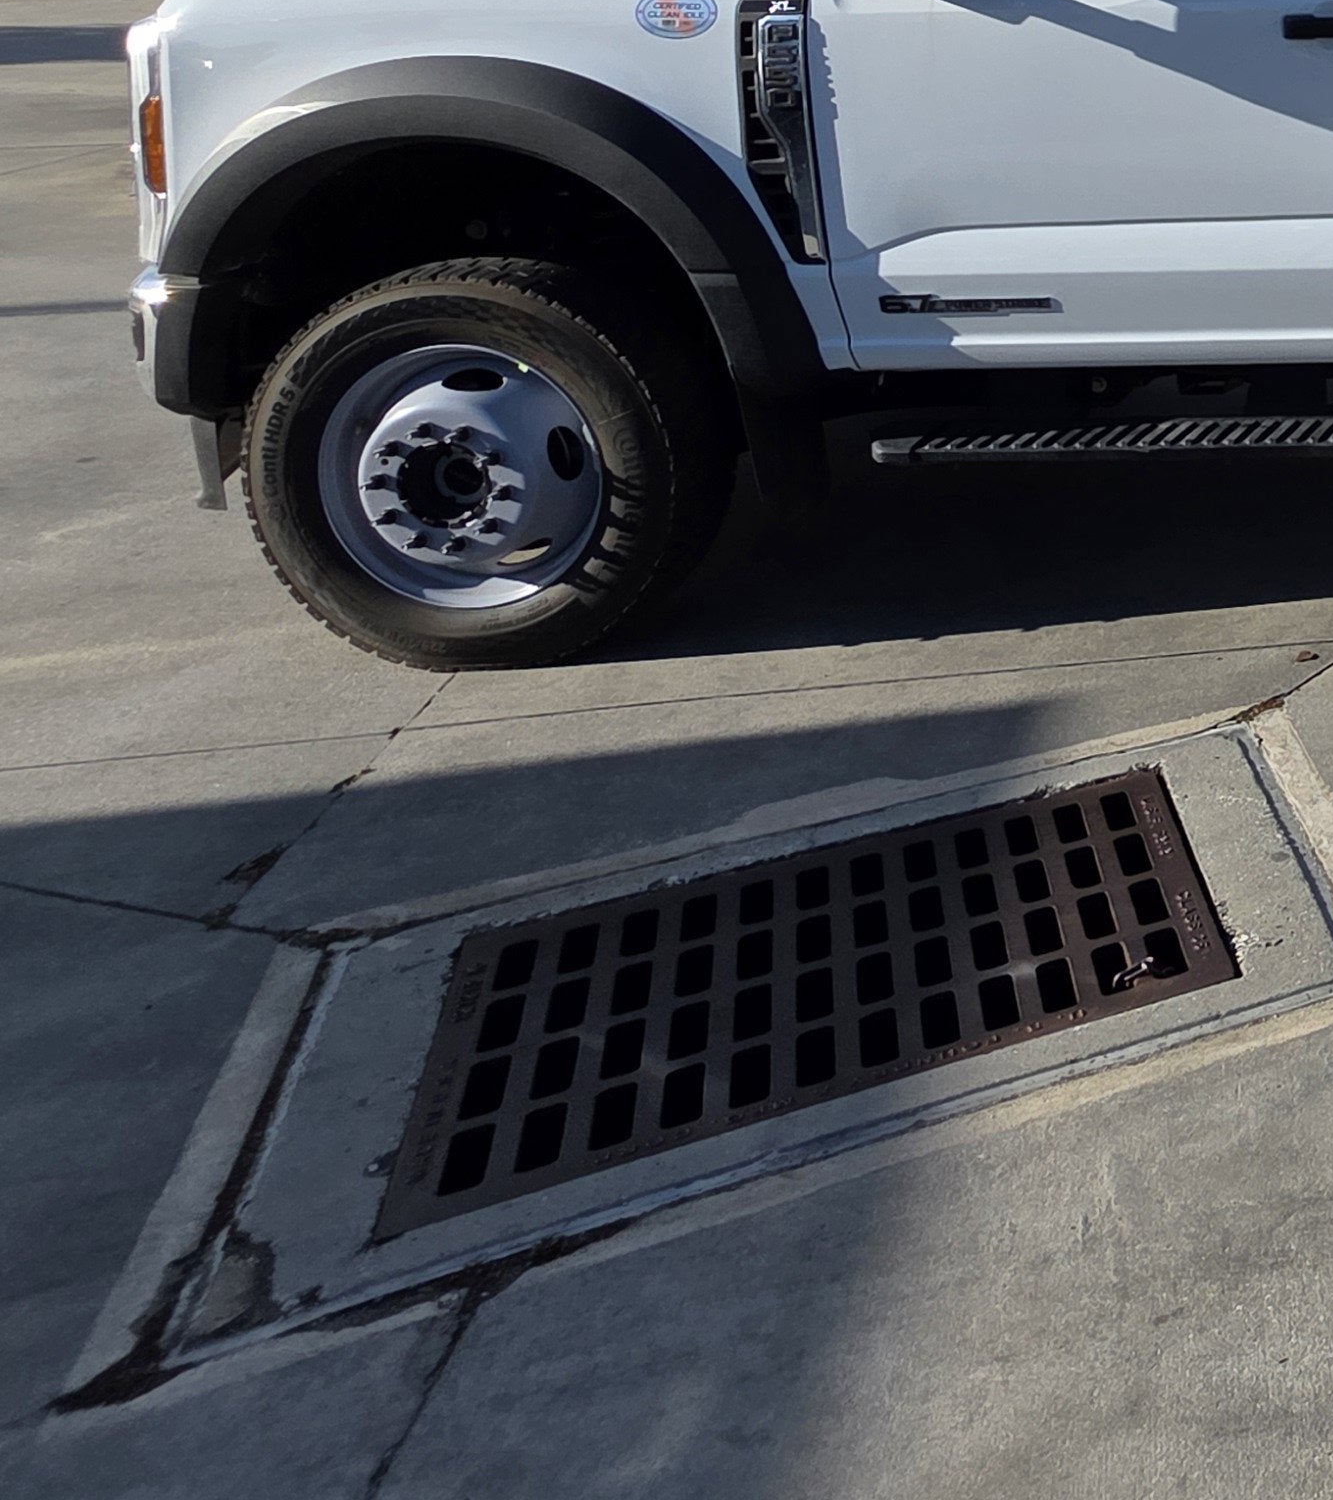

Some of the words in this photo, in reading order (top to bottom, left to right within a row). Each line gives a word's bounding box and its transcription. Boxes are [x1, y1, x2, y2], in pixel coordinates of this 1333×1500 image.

[653, 2, 702, 10] CERTIFIED
[769, 0, 796, 14] XL
[648, 11, 680, 19] CLEAN
[683, 11, 705, 19] IDLE
[879, 294, 932, 313] 6.7
[264, 400, 290, 444] HDR
